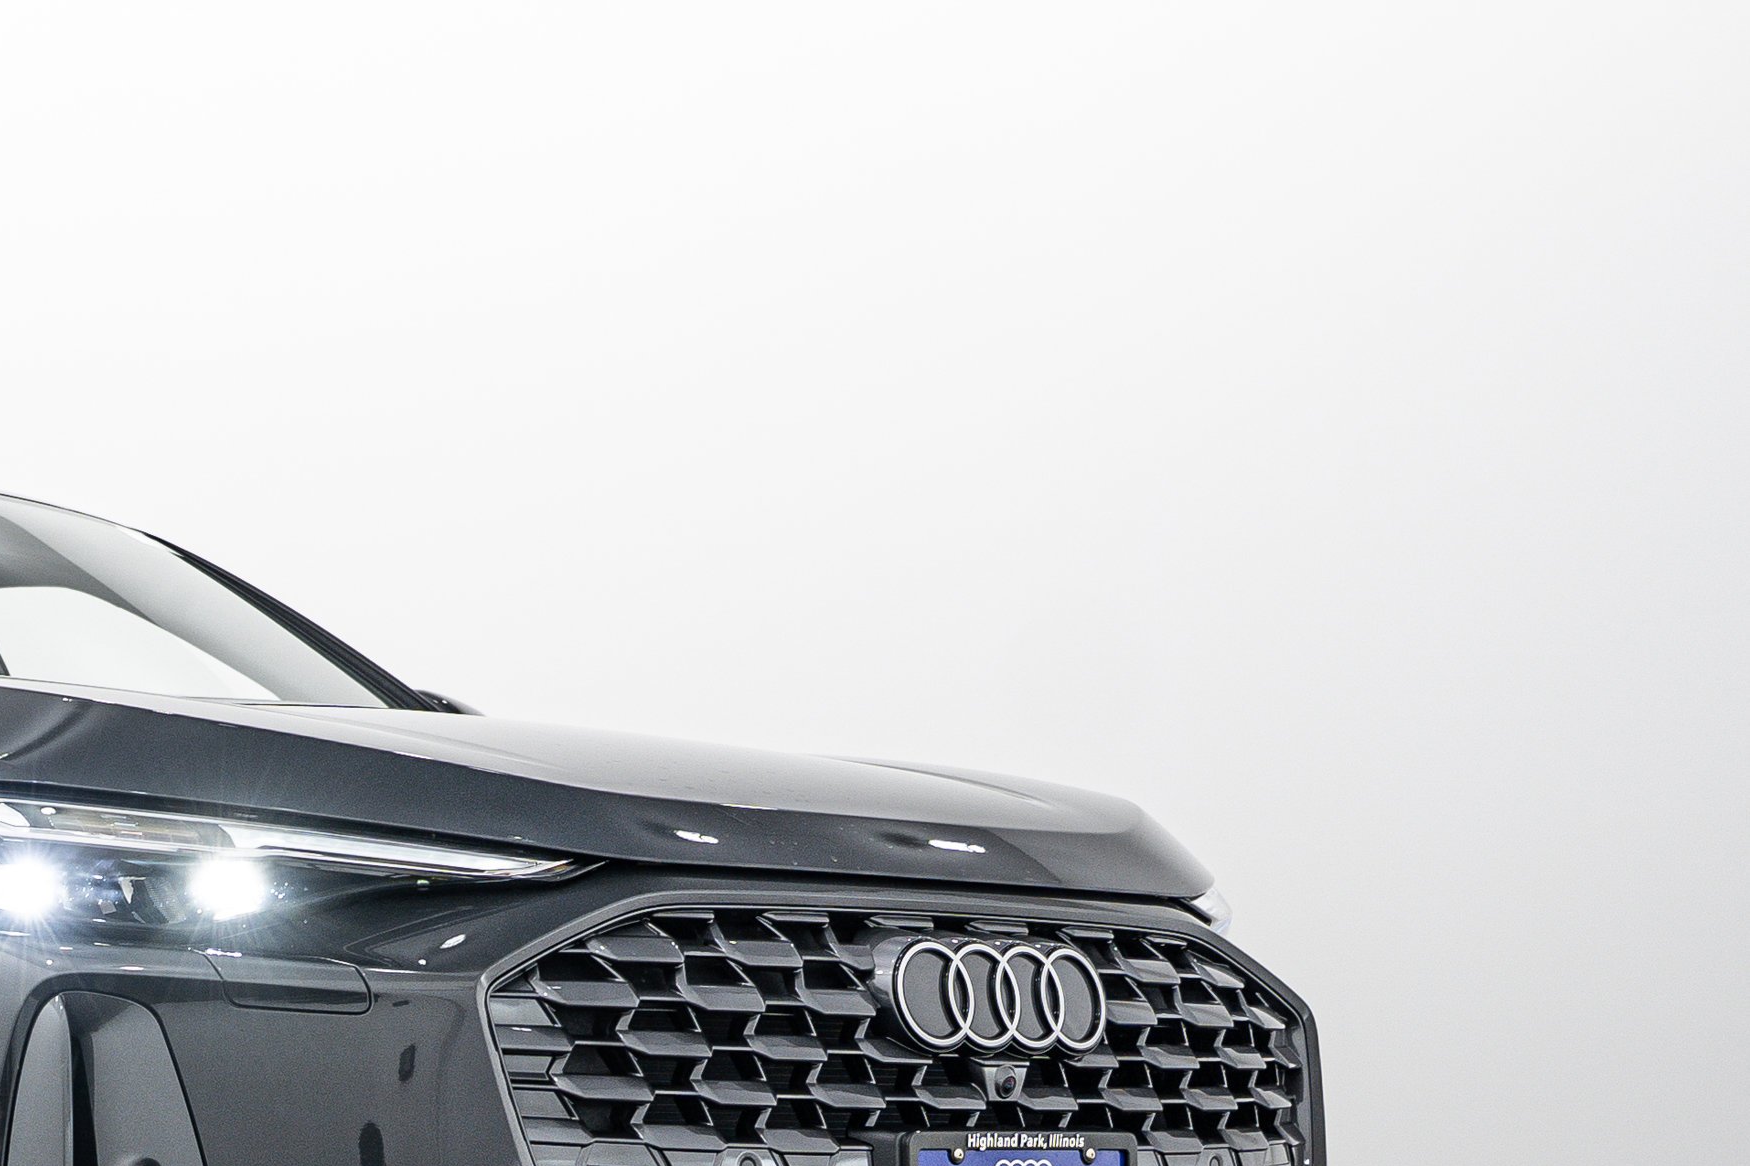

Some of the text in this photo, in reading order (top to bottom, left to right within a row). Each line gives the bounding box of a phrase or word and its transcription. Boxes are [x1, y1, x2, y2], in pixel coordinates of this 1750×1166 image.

[967, 1133, 1085, 1150] Highland Park, Illinois
